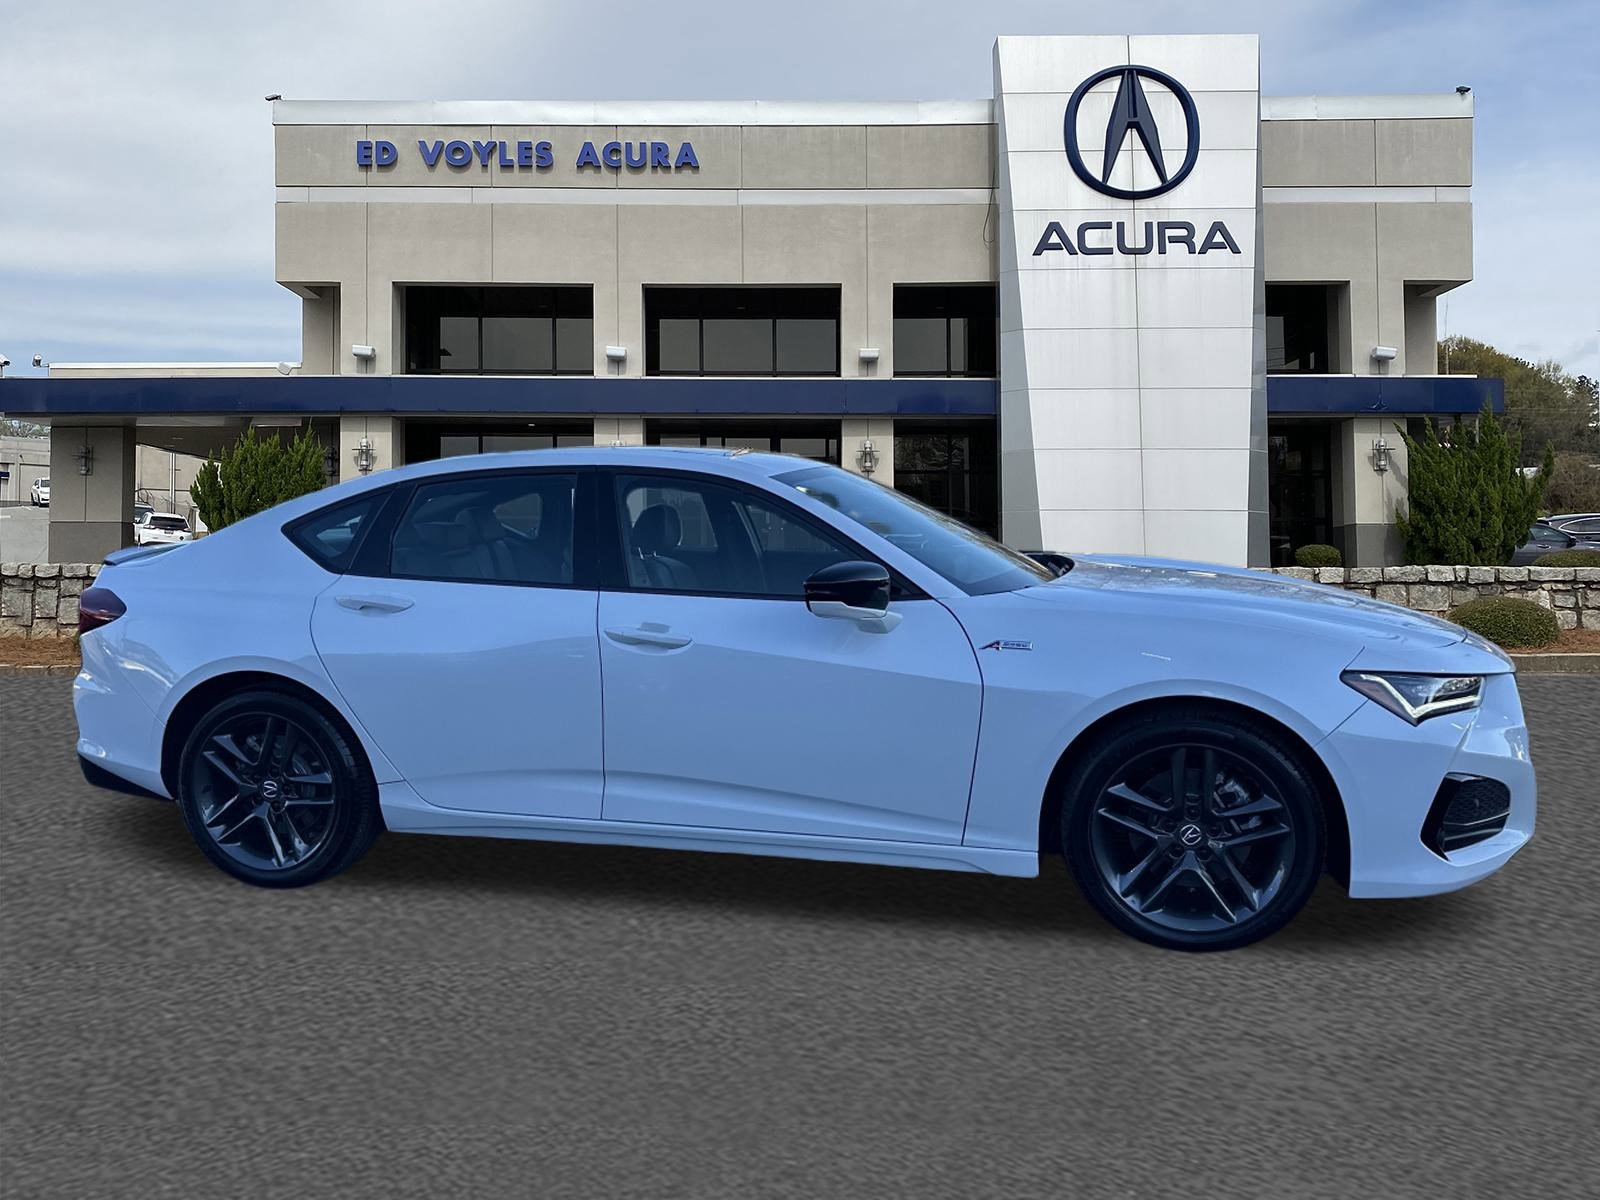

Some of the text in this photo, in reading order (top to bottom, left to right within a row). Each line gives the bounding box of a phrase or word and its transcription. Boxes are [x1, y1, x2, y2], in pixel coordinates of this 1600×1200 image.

[356, 140, 700, 169] ED VOYLES ACURA
[1032, 221, 1242, 256] ACURA
